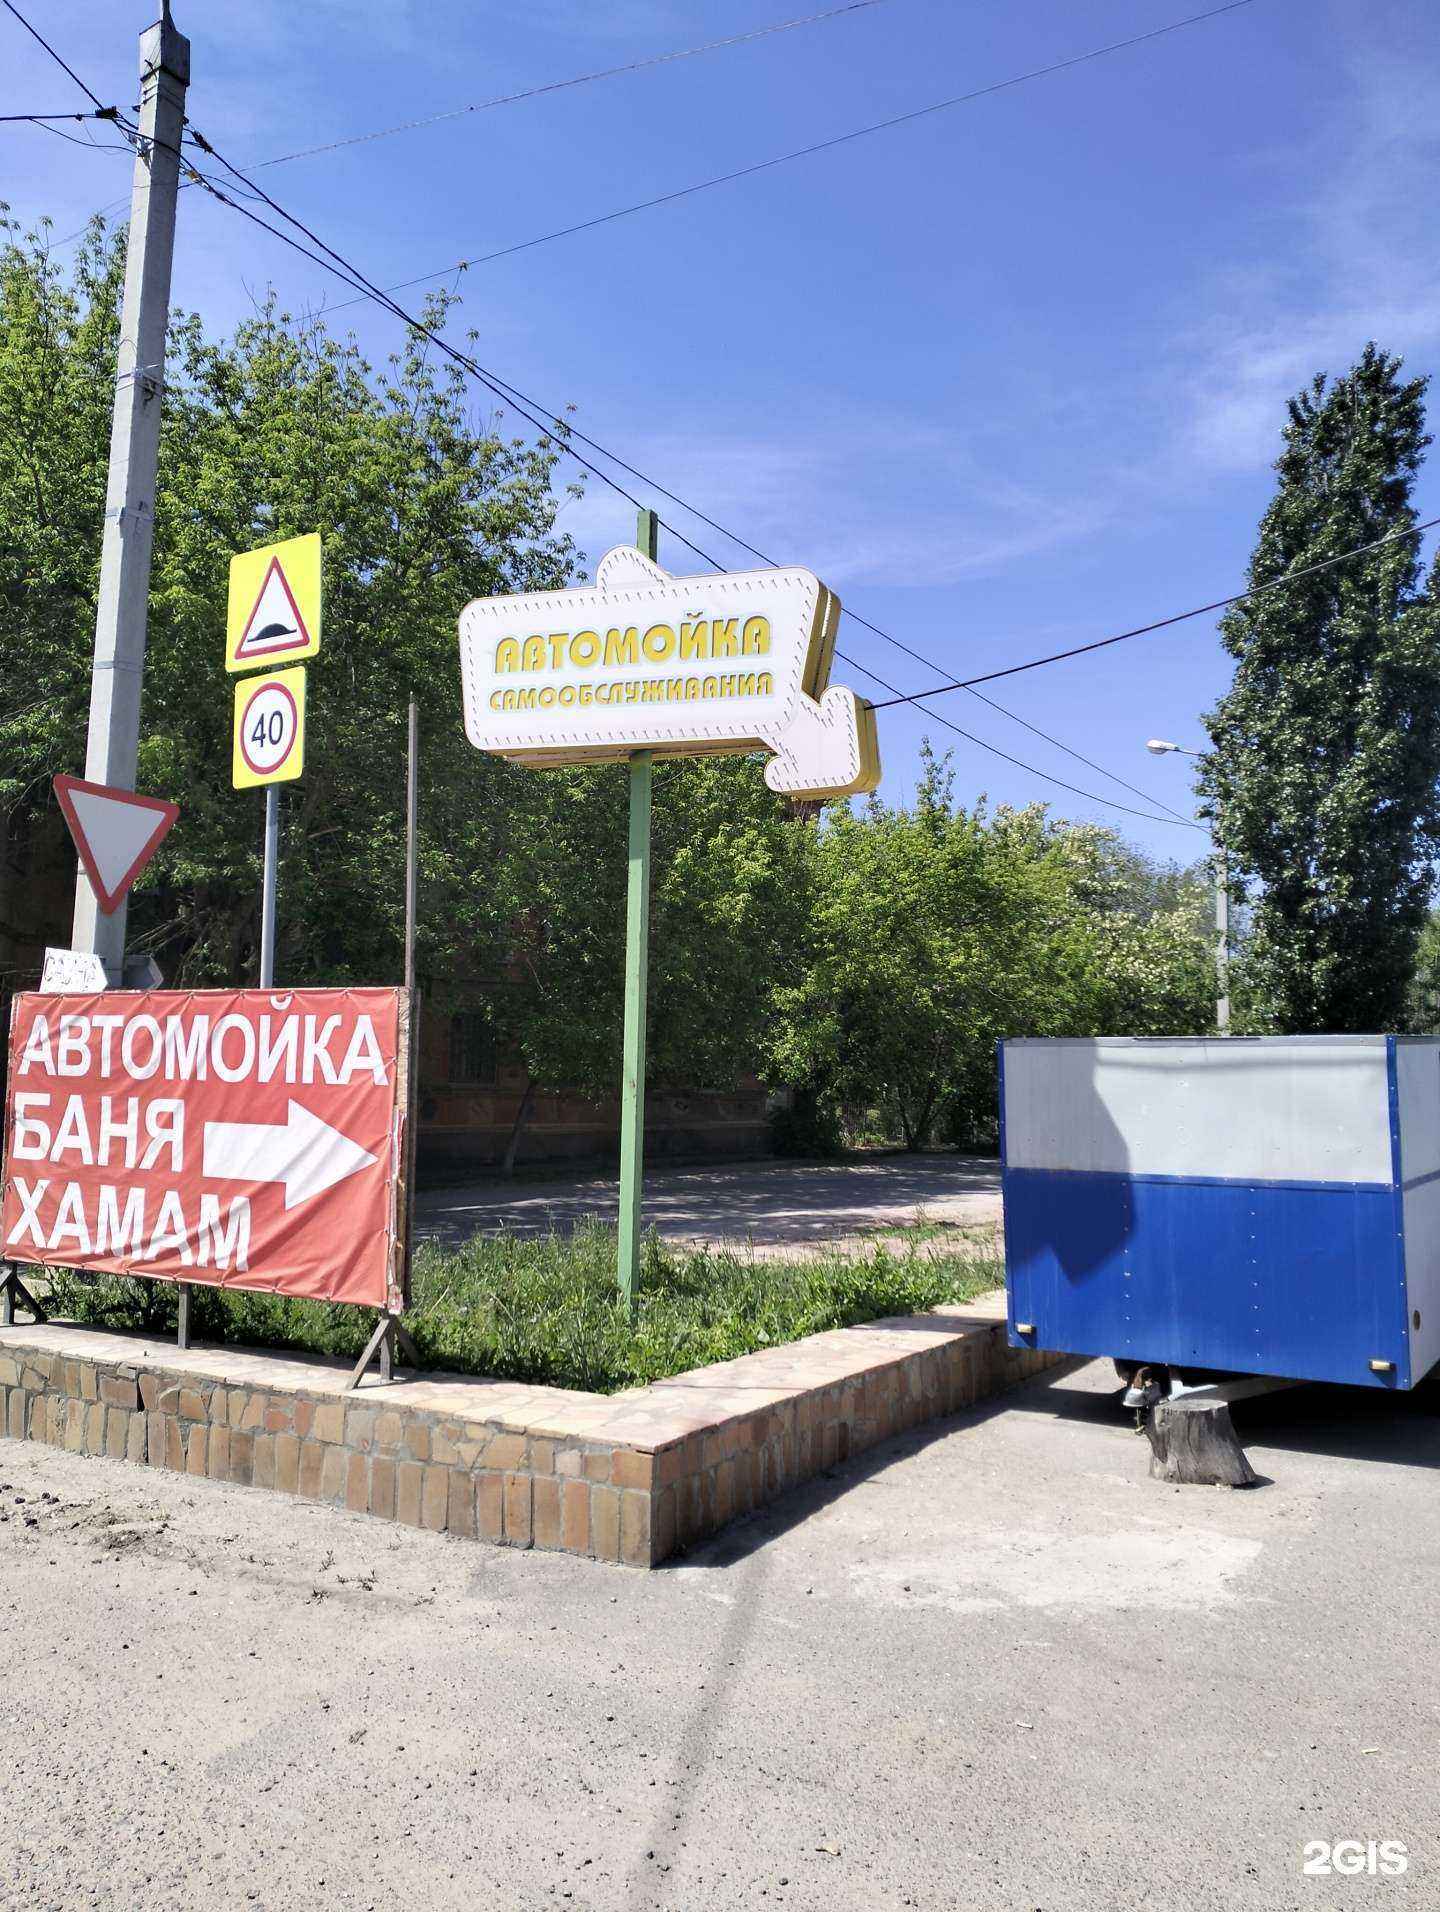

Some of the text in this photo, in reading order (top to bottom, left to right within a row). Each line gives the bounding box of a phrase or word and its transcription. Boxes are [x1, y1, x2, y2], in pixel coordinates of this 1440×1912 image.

[495, 611, 771, 673] АВТОМОЙКА
[489, 672, 774, 711] САМООБСЛУЖИВАНИЯ
[250, 710, 284, 748] 40
[17, 996, 389, 1086] АВТОМОЙКА
[12, 1093, 185, 1172] БАНЯ
[6, 1177, 251, 1272] ХАМАМ
